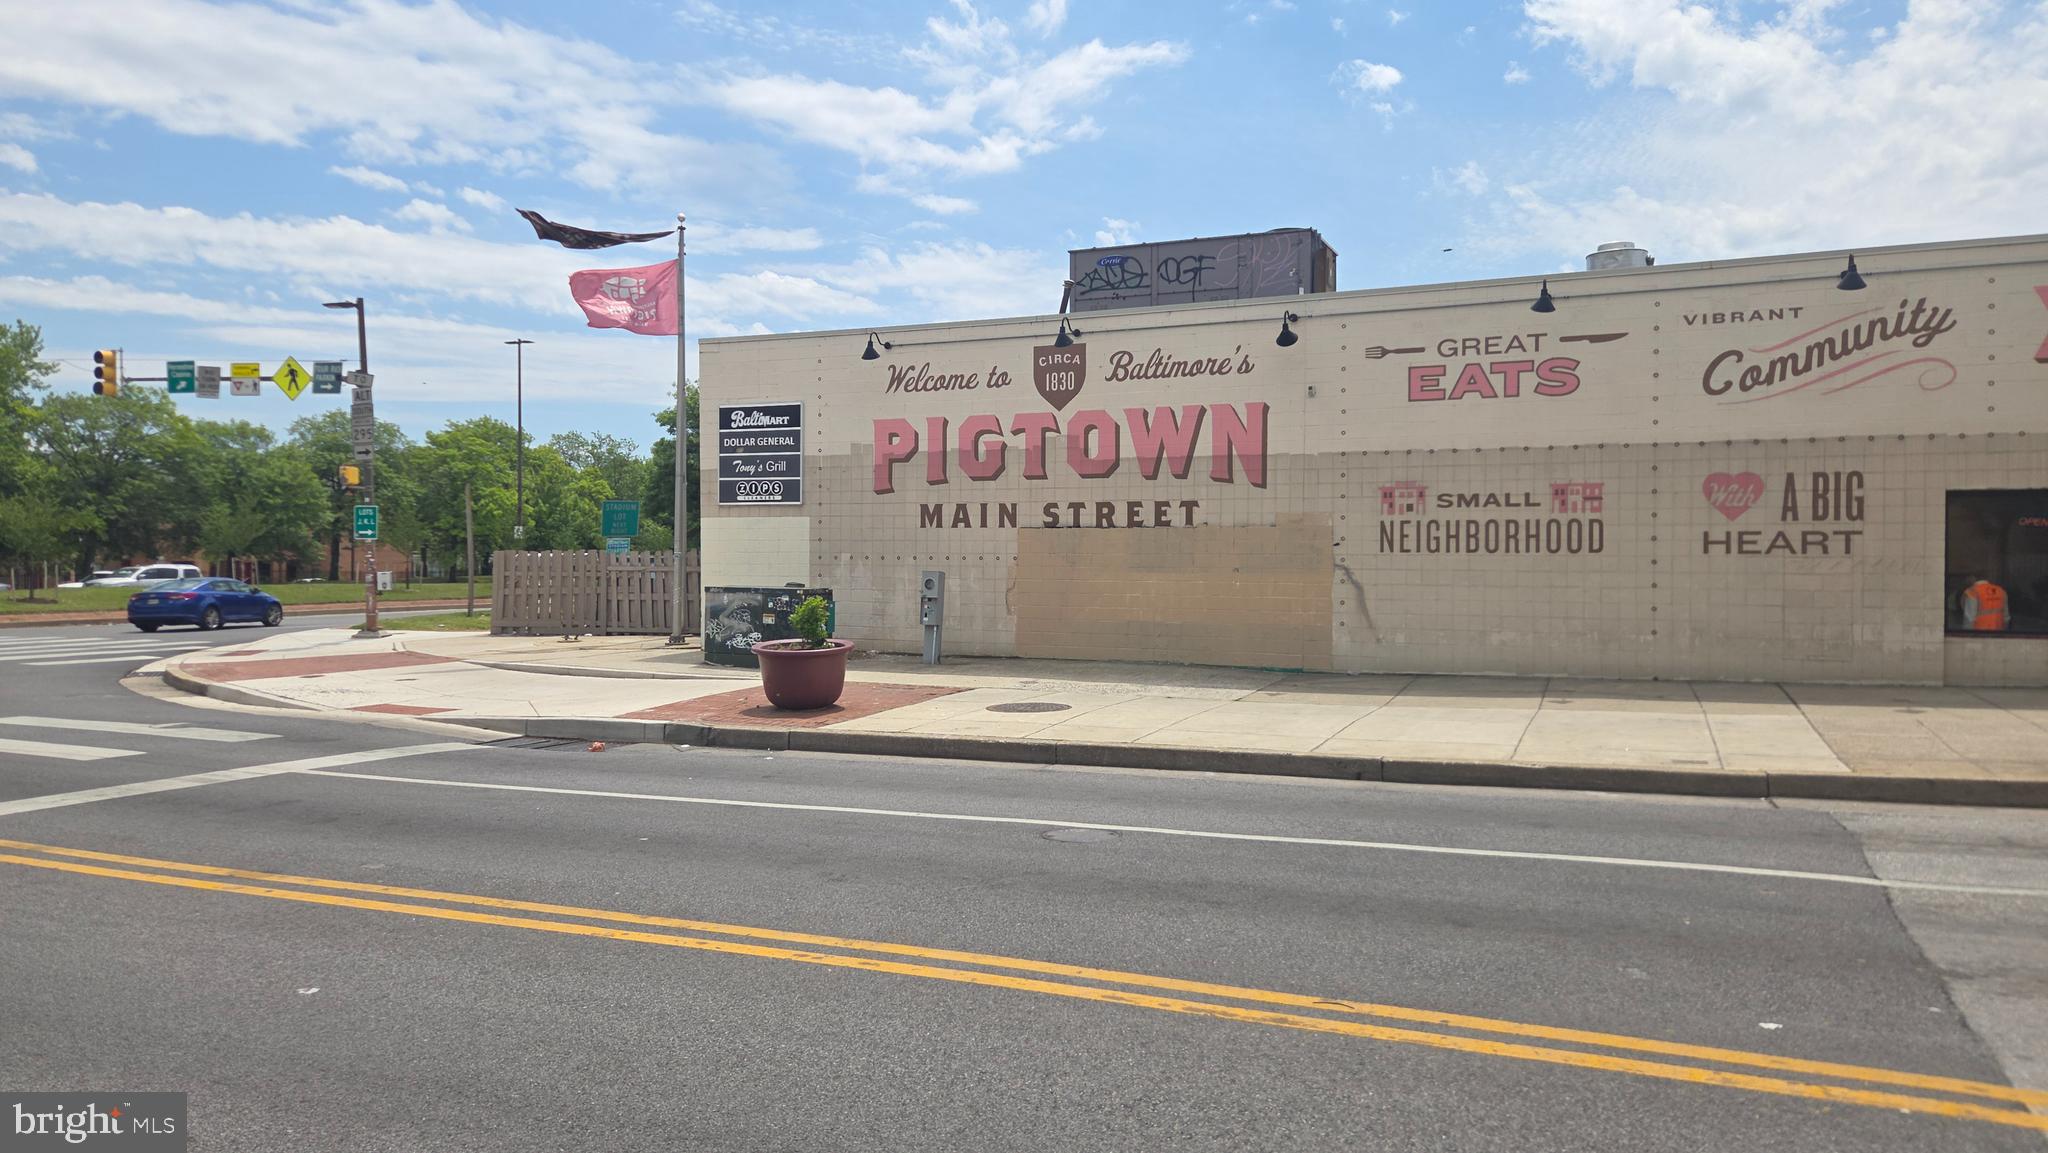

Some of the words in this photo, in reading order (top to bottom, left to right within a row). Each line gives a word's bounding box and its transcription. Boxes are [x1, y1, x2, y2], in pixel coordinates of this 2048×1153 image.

[1682, 306, 1804, 326] VIBRANT
[1437, 333, 1548, 358] GREAT
[1702, 297, 1957, 396] Community
[885, 362, 979, 394] Welcome
[986, 365, 1012, 389] to
[1104, 344, 1255, 383] Baltimore's
[1039, 353, 1081, 367] CIRCA
[1046, 371, 1075, 392] 1830
[1408, 357, 1581, 402] EATS
[354, 390, 371, 401] ALT
[354, 428, 373, 441] 295
[724, 438, 756, 447] DOLLAR
[757, 437, 795, 446] GENERAL
[873, 402, 1270, 495] PIGTOWN
[732, 460, 763, 475] Tony's
[766, 461, 786, 472] Grill
[737, 482, 782, 494] ZIPS
[1709, 482, 1756, 508] With
[1781, 471, 1799, 522] A
[1812, 470, 1865, 522] BIG
[605, 502, 637, 511] STADIUM
[1436, 492, 1541, 509] SMALL
[920, 502, 1018, 529] MAIN
[1043, 500, 1200, 529] STREET
[1379, 518, 1604, 555] NEIGHBORHOOD
[1703, 530, 1864, 556] HEART
